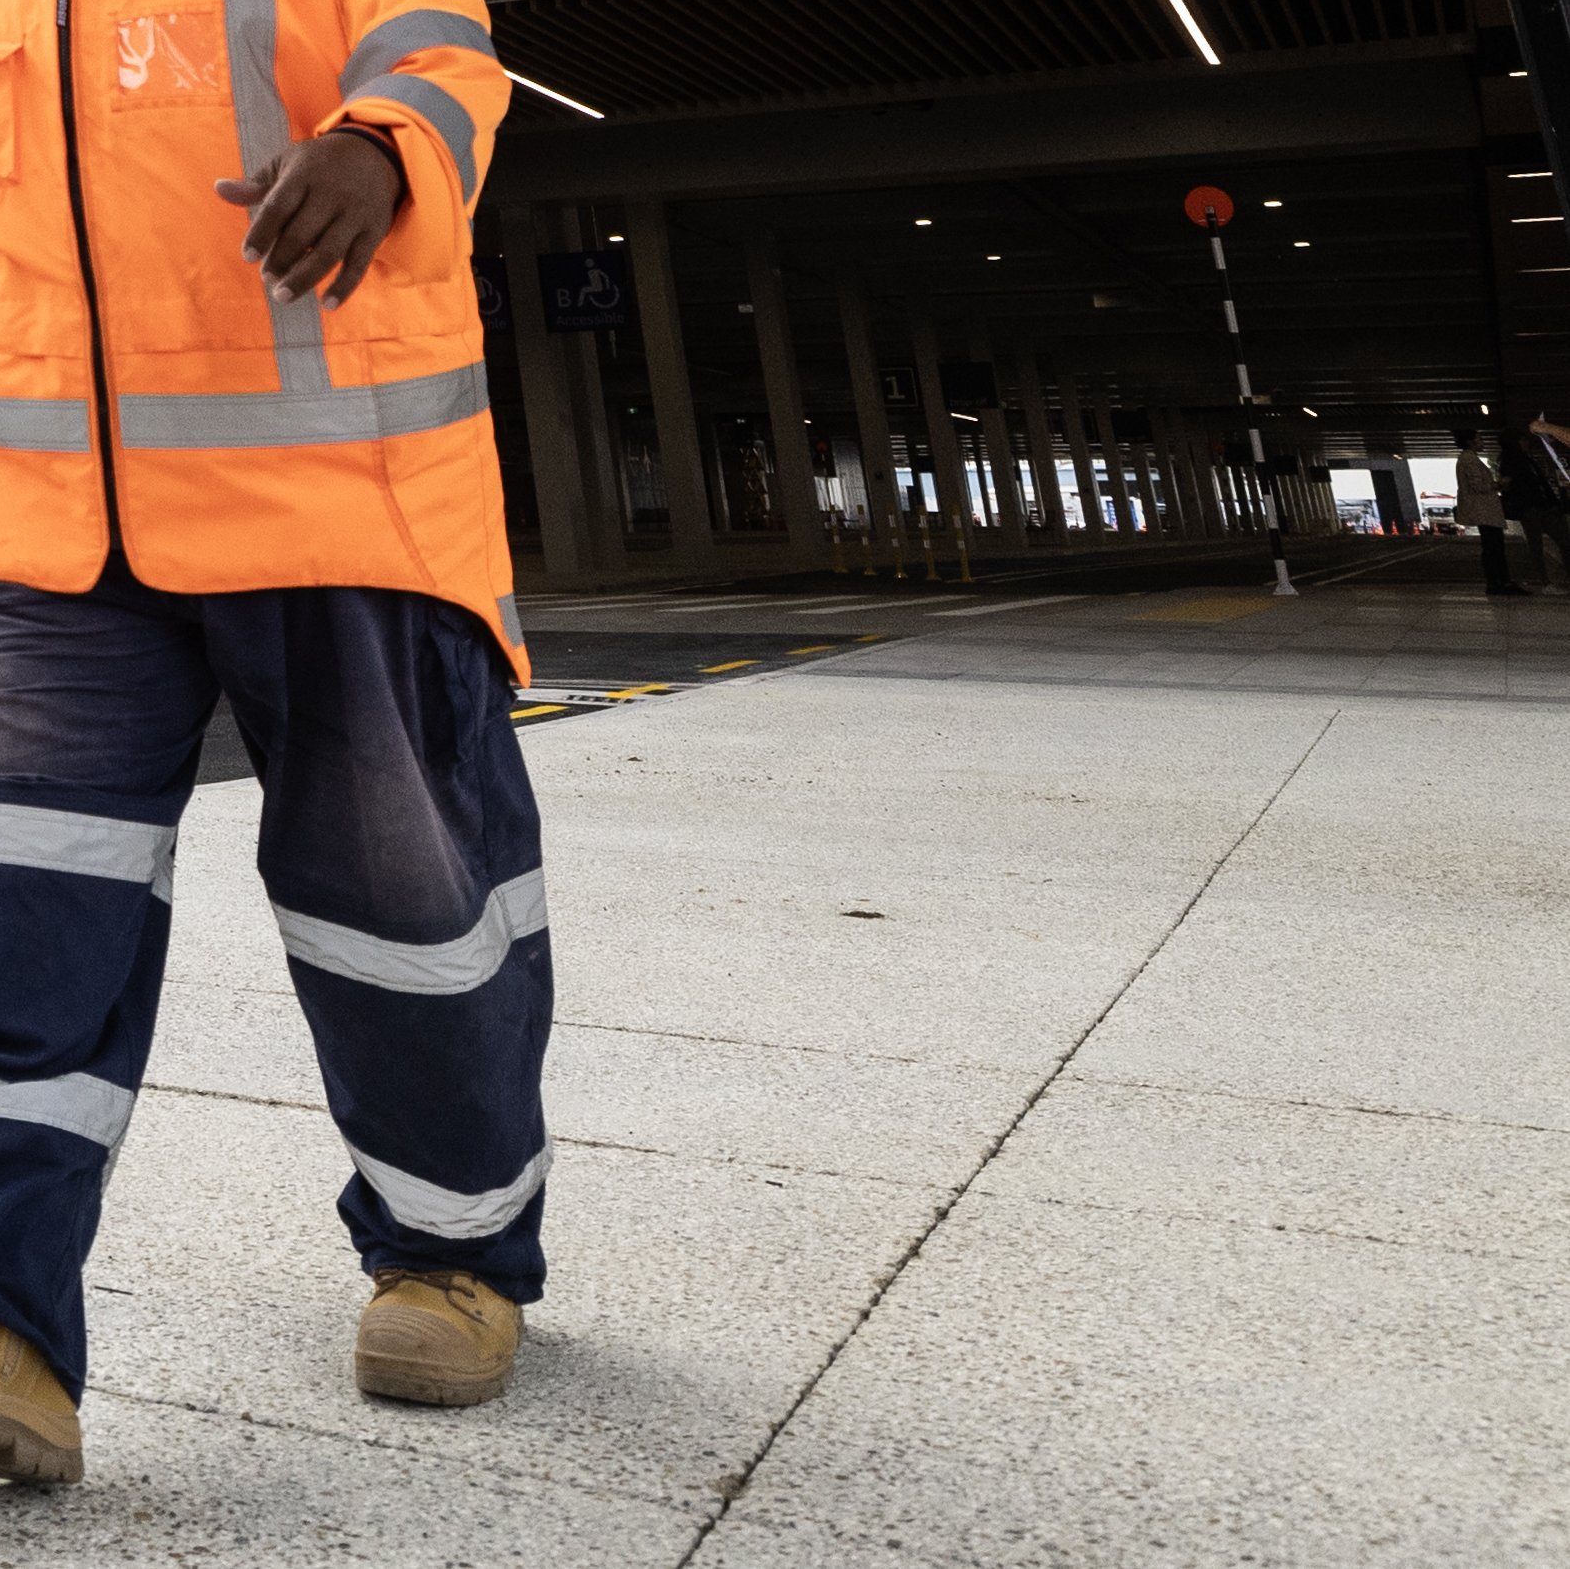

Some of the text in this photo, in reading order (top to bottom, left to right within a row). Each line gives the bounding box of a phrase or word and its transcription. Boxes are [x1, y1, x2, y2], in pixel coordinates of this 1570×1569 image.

[556, 288, 572, 308] B
[556, 312, 625, 327] Accessible
[884, 376, 906, 399] 1
